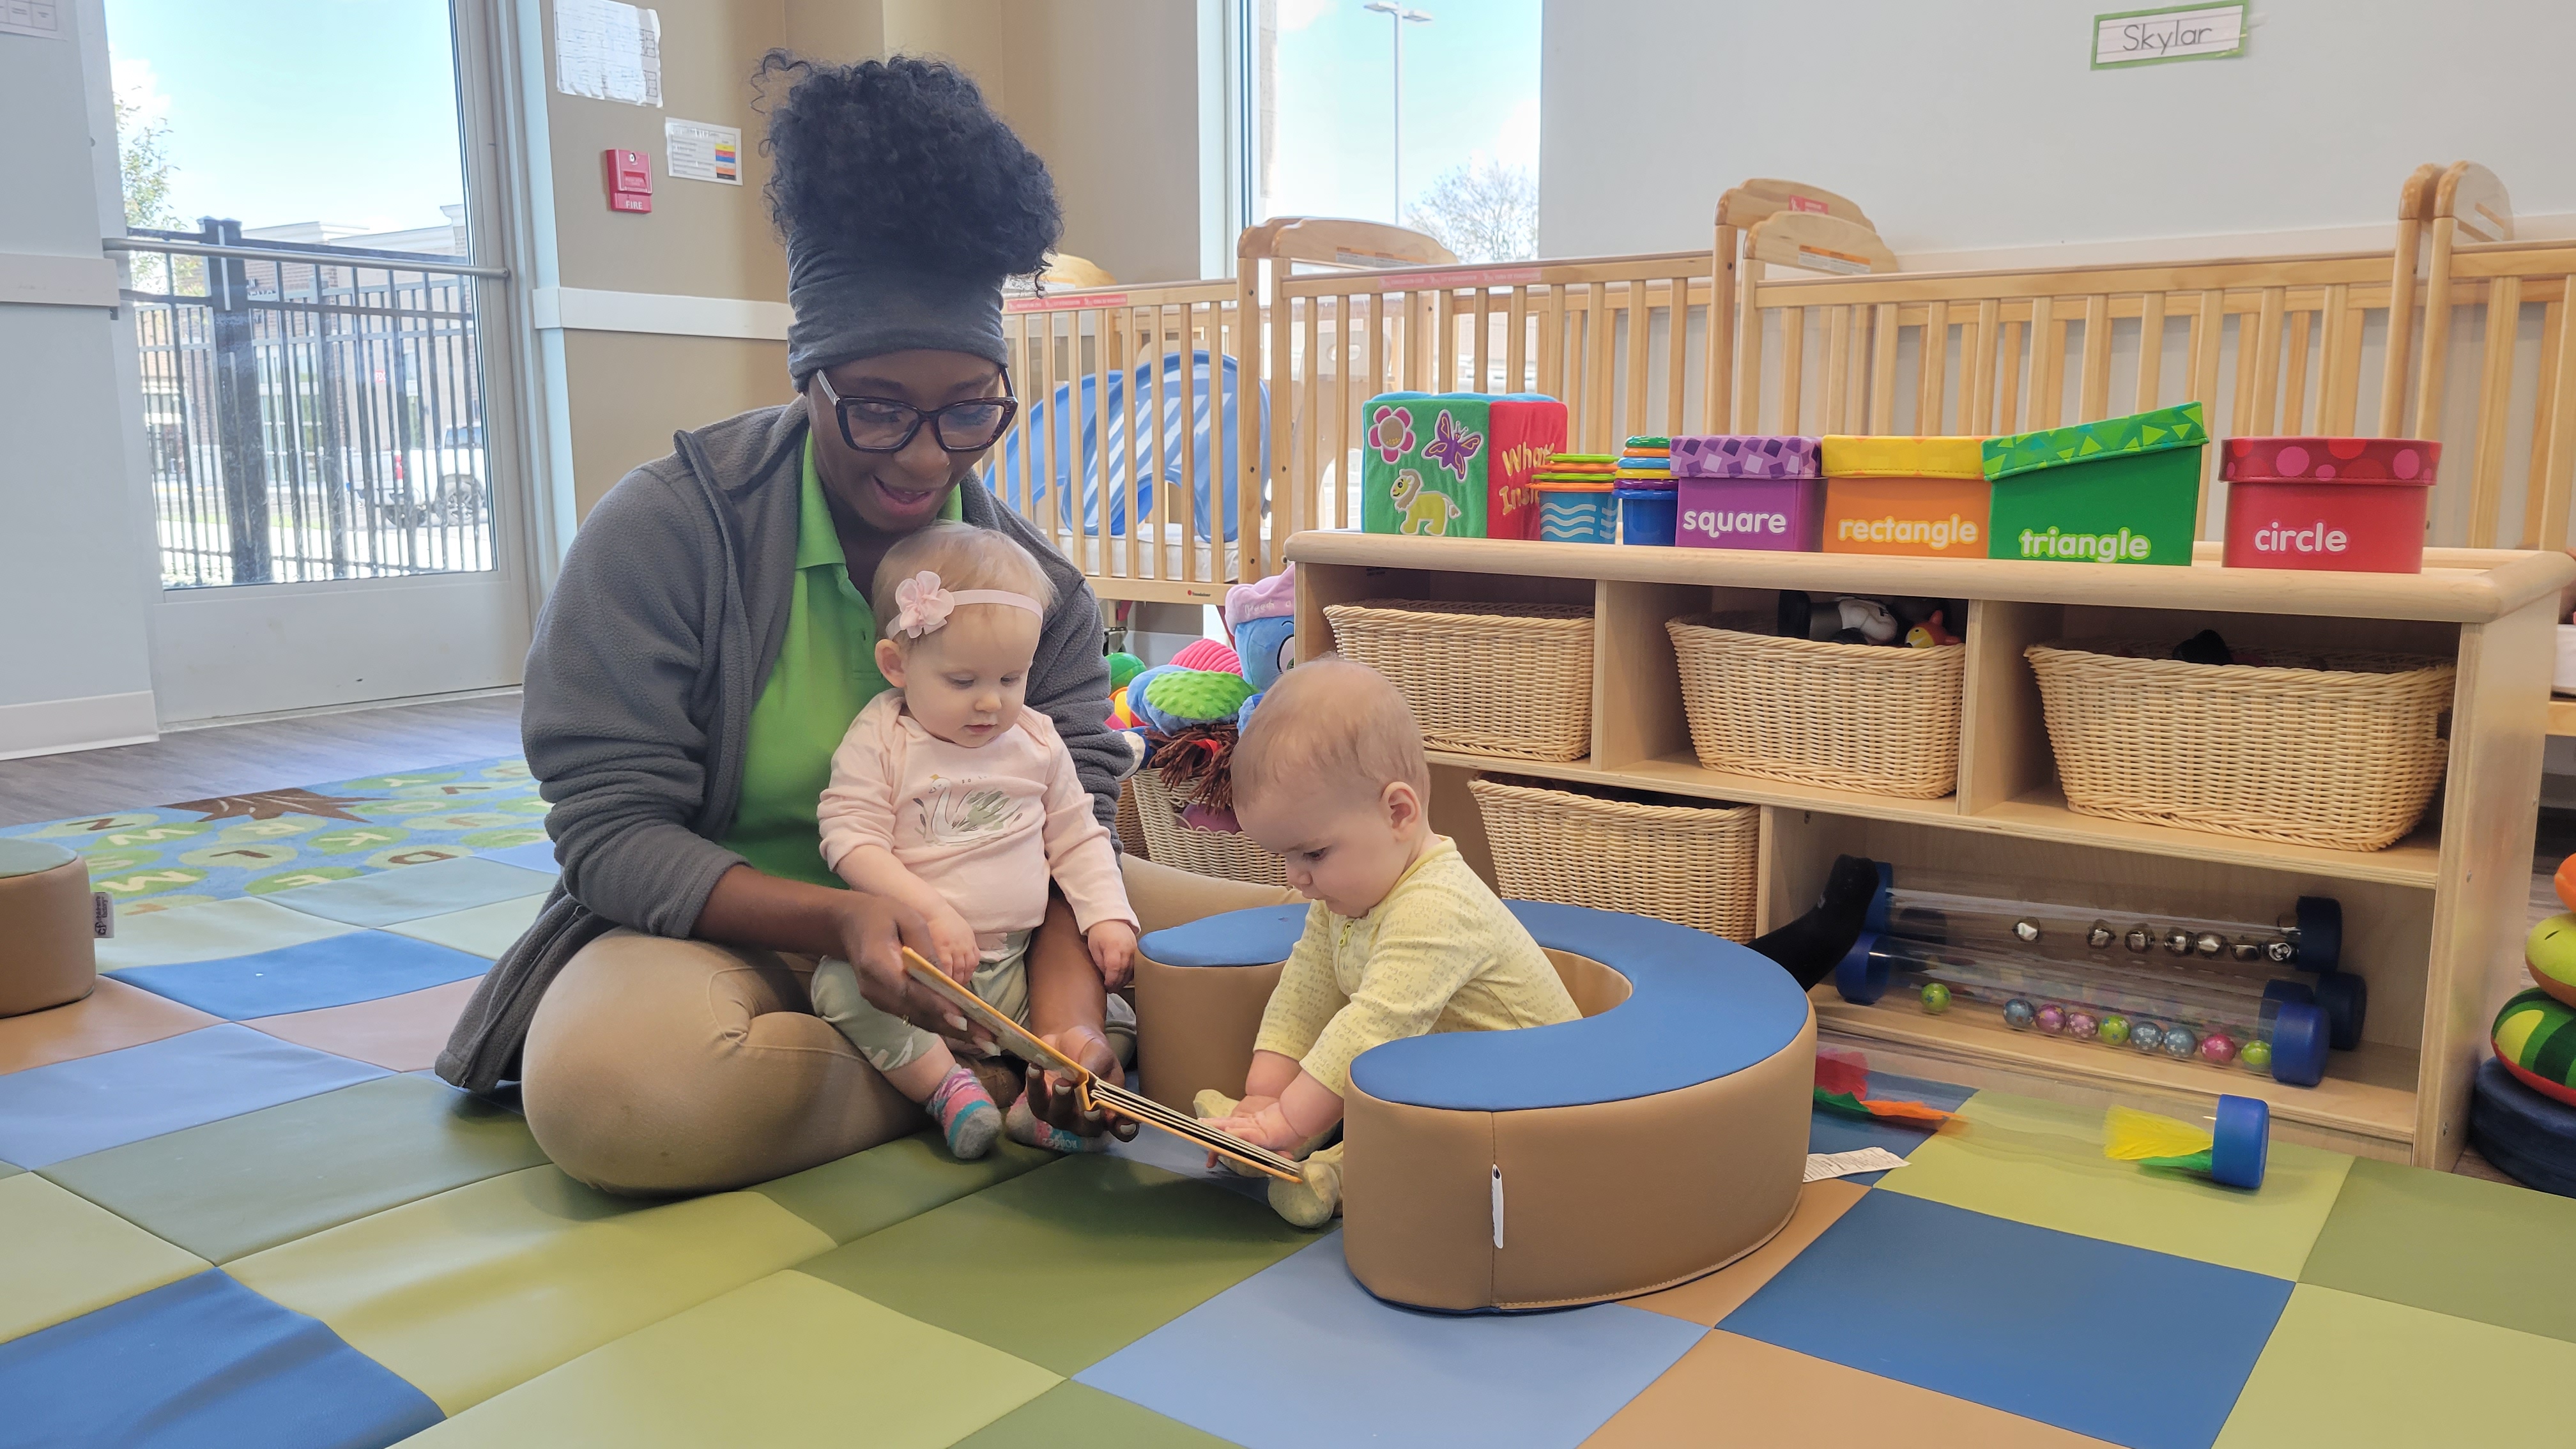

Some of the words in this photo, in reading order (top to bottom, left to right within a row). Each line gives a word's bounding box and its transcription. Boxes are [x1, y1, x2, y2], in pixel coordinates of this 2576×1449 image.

[2122, 20, 2212, 55] Skylar
[625, 201, 643, 210] FIRE
[1683, 510, 1786, 538] square
[1839, 514, 1979, 548] rectangle
[2255, 521, 2347, 552] circle
[2021, 528, 2149, 563] triangle
[65, 818, 135, 831] Z
